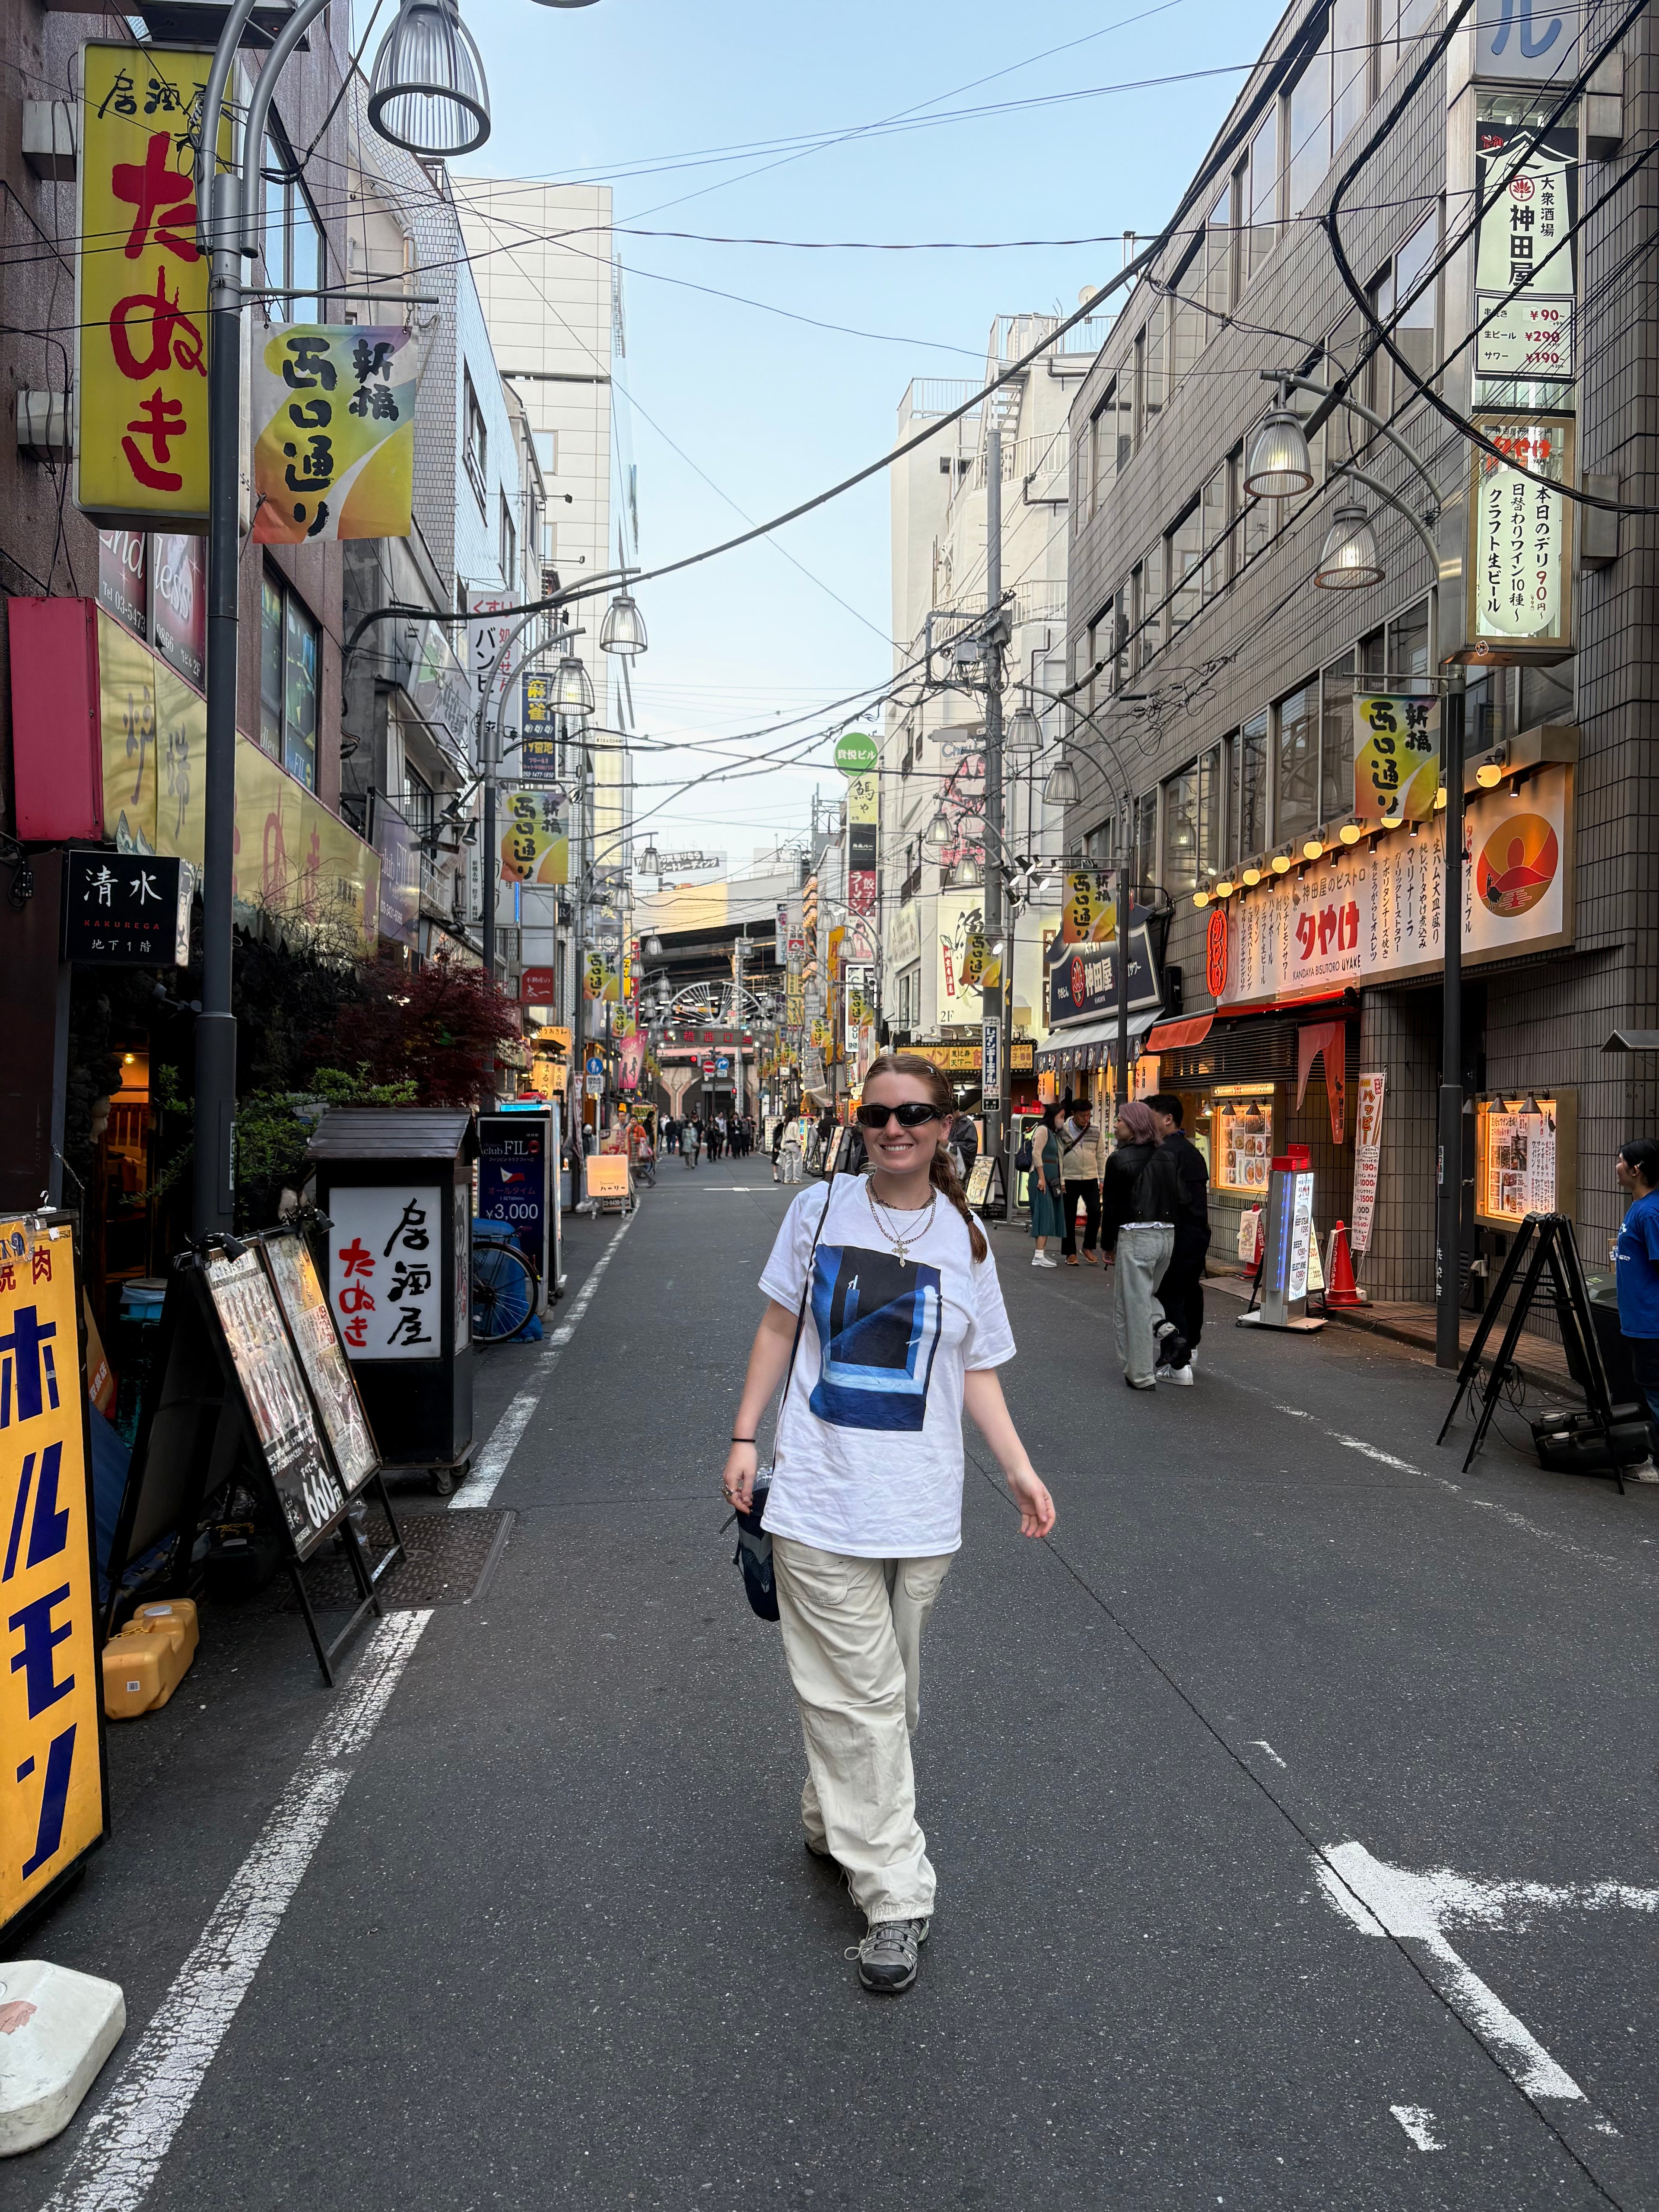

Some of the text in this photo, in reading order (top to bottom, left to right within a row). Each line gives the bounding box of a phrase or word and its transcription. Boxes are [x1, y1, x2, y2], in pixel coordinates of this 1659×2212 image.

[1540, 177, 1554, 238] 大衆酒場
[1509, 204, 1535, 287] 神田屋
[110, 131, 207, 491] たぬき
[1484, 331, 1516, 340] 生ビール
[349, 339, 399, 421] 新橋
[1484, 351, 1509, 360] サワー
[283, 337, 337, 537] 西口通り
[1487, 489, 1502, 613] クラフト生ビール
[103, 582, 113, 601] Tel
[115, 591, 146, 633] 03-5473
[527, 680, 547, 721] 麻雀
[1405, 702, 1432, 753] 新橋
[837, 750, 876, 760] 貴悦ビル
[1369, 702, 1400, 815] 西口通り
[514, 797, 536, 880] 西口通り
[542, 799, 562, 835] 新橋
[84, 865, 163, 907] 清水
[851, 871, 864, 915] ラーメン
[1073, 874, 1091, 941] 西口通り
[1095, 874, 1112, 903] 新橋
[1302, 868, 1366, 903] 神田屋のビストロ
[1381, 856, 1390, 959] ナポリタンチーズ焼き
[1394, 850, 1403, 953] ガーリックトーストタワー
[1407, 847, 1415, 937] マリナーラ
[1431, 837, 1442, 945] 生ハム大皿盛り
[84, 920, 160, 931] KAKUREGA
[92, 939, 152, 953] 地下1階
[1295, 900, 1360, 961] 夕やけ
[1084, 956, 1113, 998] 神田屋
[1293, 954, 1362, 981] KANDAYA BISUTORO UYAKE
[940, 1010, 954, 1022] 2F
[985, 1027, 996, 1084] レインボーホテル
[1362, 1090, 1376, 1145] ハッピー
[486, 1203, 539, 1220] ¥3,000
[339, 1237, 376, 1347] たぬき
[384, 1198, 432, 1345] 居酒屋
[0, 1305, 77, 1882] ホルモン
